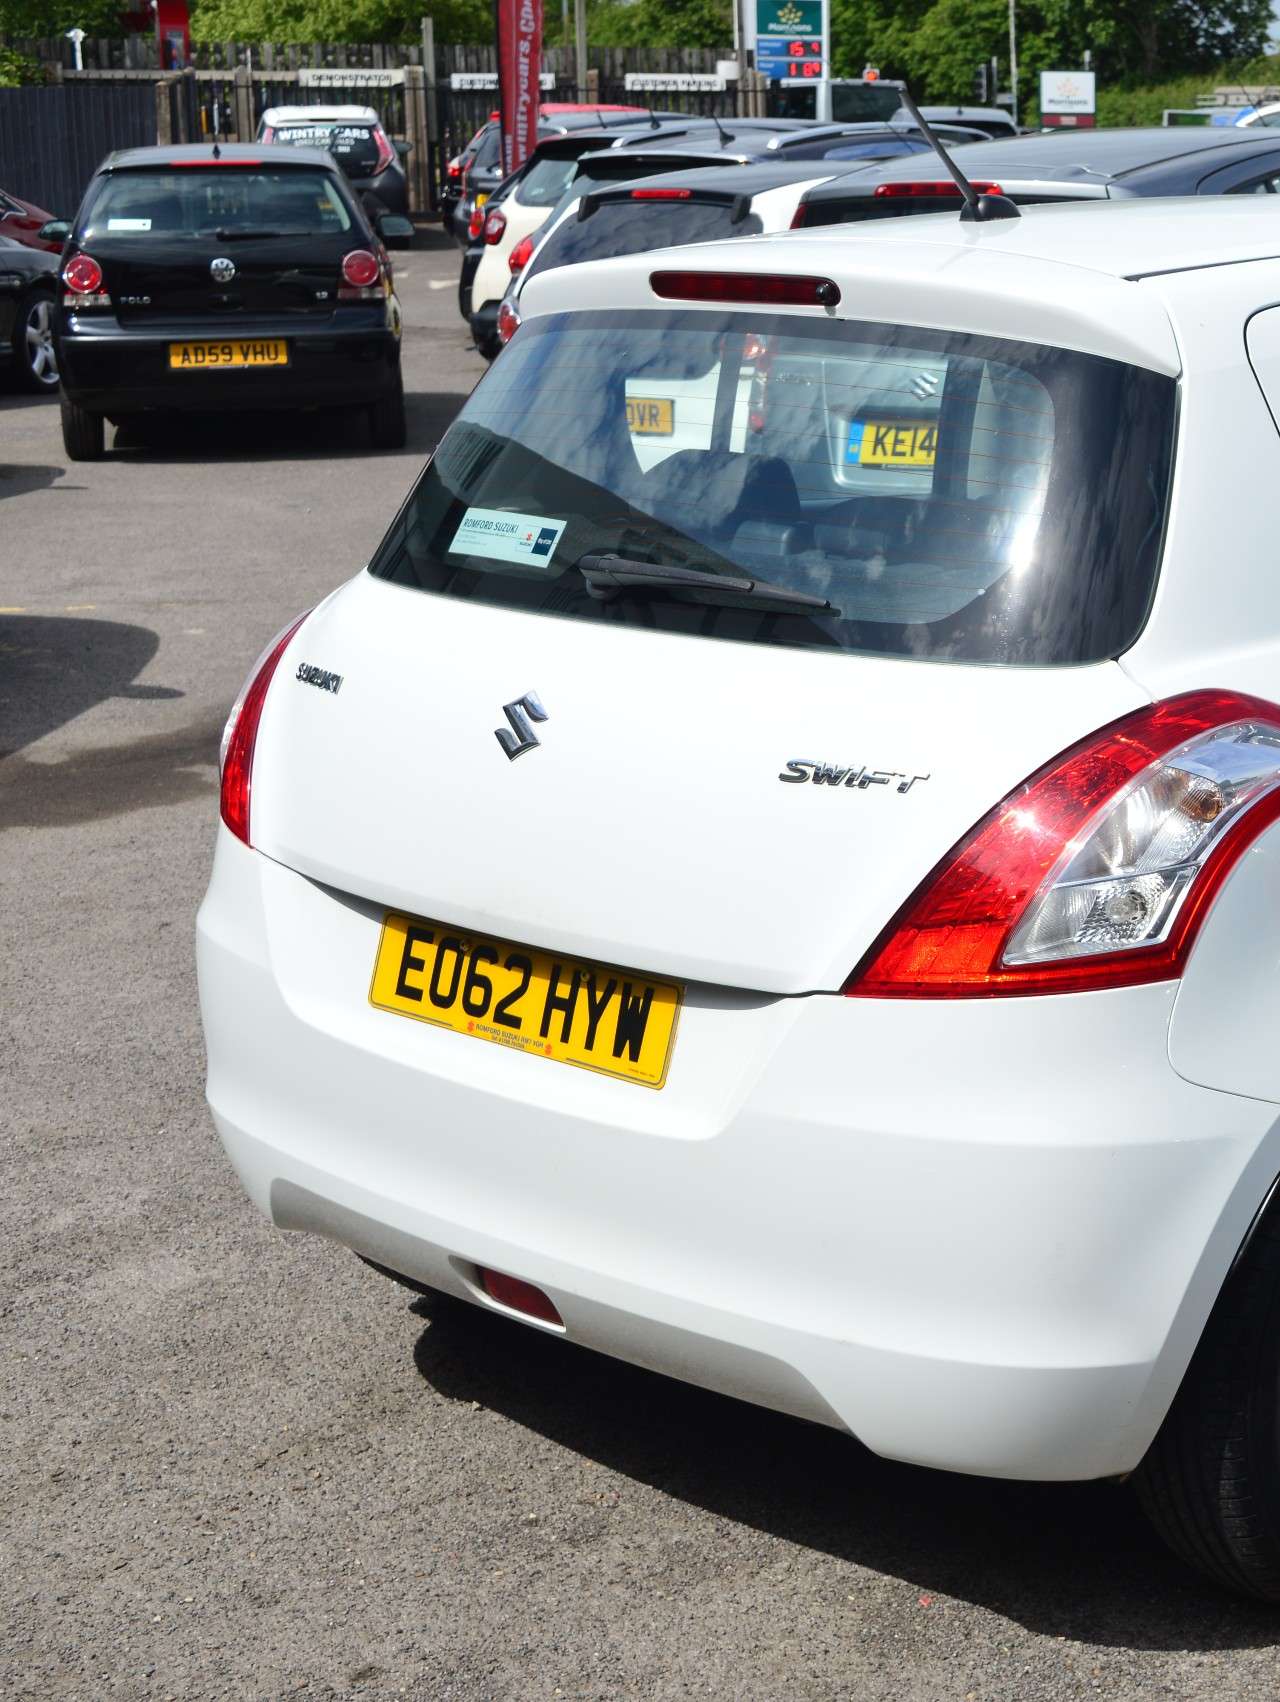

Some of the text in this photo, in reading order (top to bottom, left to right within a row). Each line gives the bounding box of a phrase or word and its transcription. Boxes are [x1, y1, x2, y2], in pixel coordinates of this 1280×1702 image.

[278, 127, 331, 141] WINTRY
[181, 342, 279, 365] AD59 VHU
[872, 424, 937, 458] KE14
[463, 518, 520, 535] ROMFORD SUZUKI
[295, 661, 345, 696] SUZUKI
[777, 757, 931, 794] SWIFT
[394, 925, 655, 1063] EO62 HYW
